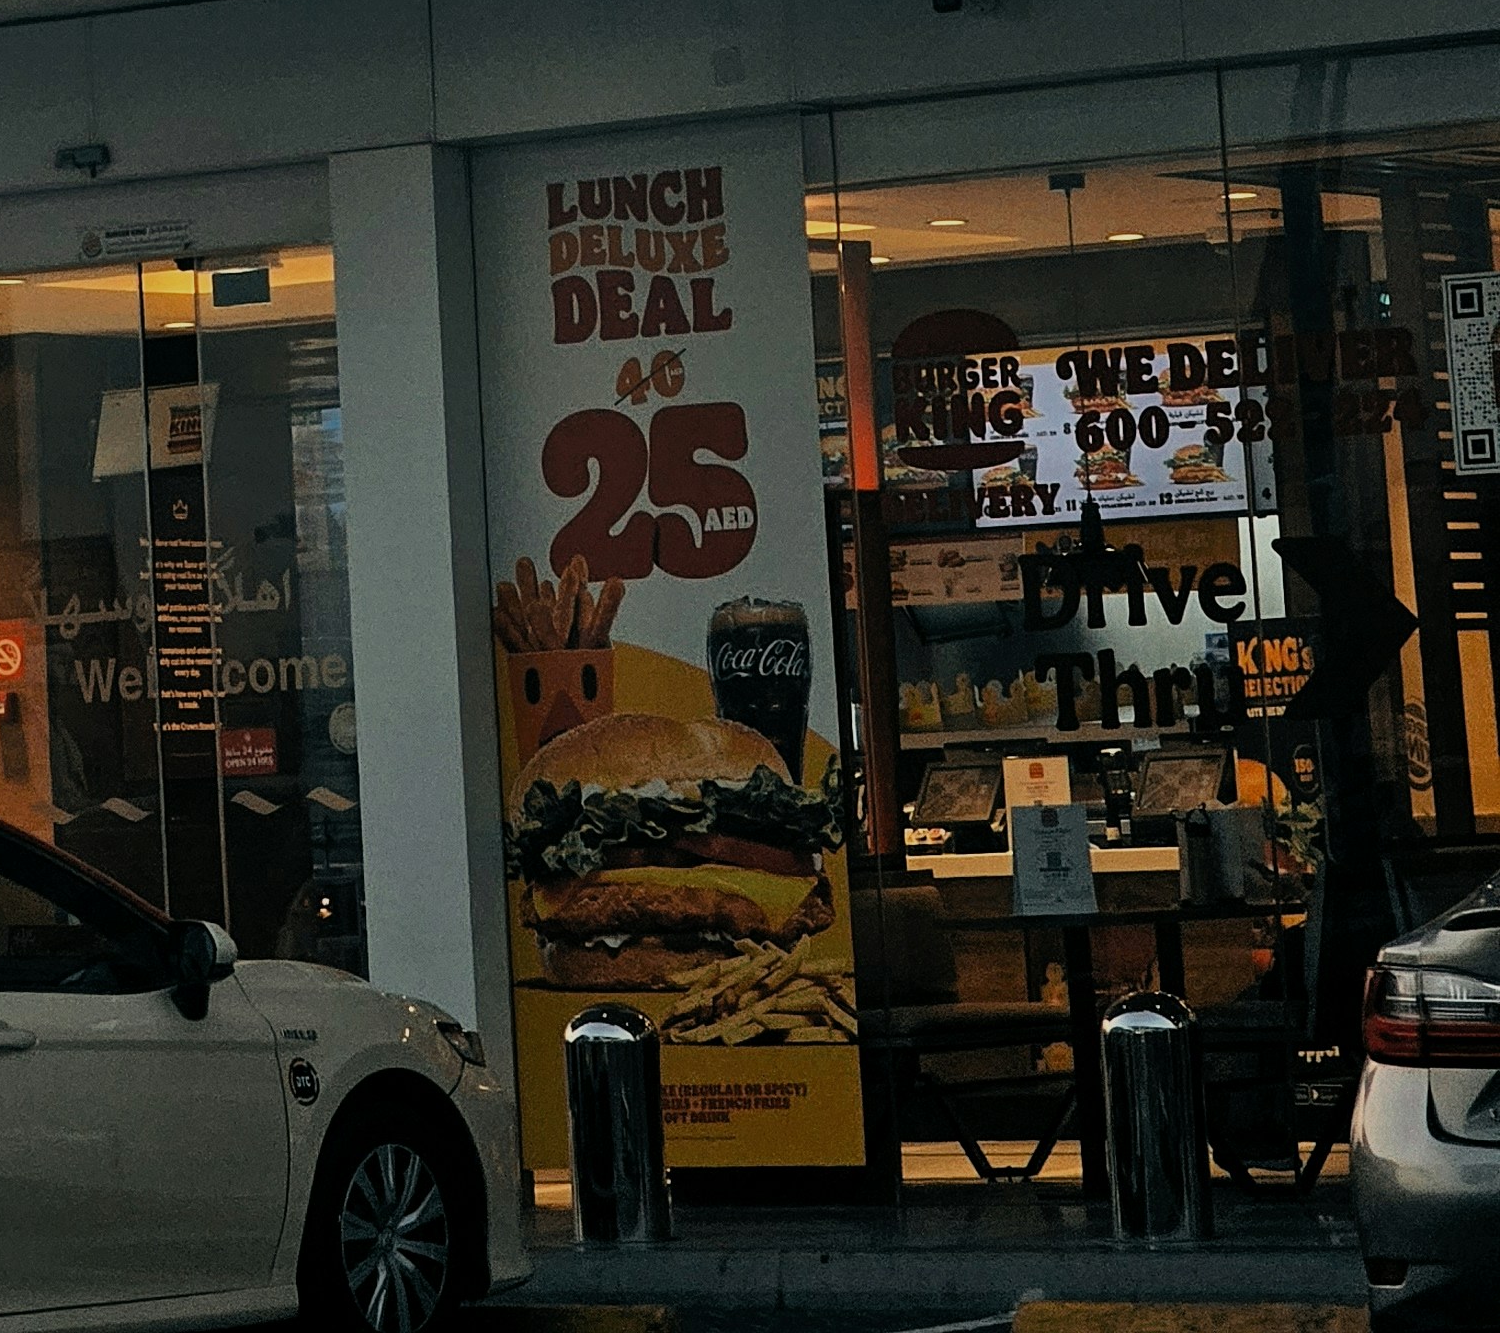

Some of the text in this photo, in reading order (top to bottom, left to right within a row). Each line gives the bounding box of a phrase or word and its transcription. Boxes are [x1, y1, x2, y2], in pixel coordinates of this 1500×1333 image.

[545, 166, 725, 230] LUNCH
[548, 223, 731, 276] DELUXE
[550, 269, 733, 345] DEAL
[892, 356, 1022, 394] BURGER
[1055, 345, 1159, 398] WE
[895, 390, 1025, 441] KING
[541, 401, 759, 582] 25
[704, 505, 754, 532] AED
[1018, 543, 1247, 632] Drive
[73, 649, 351, 706] Welcome
[715, 639, 804, 682] Coca-Cola
[1236, 635, 1316, 675] KNG's
